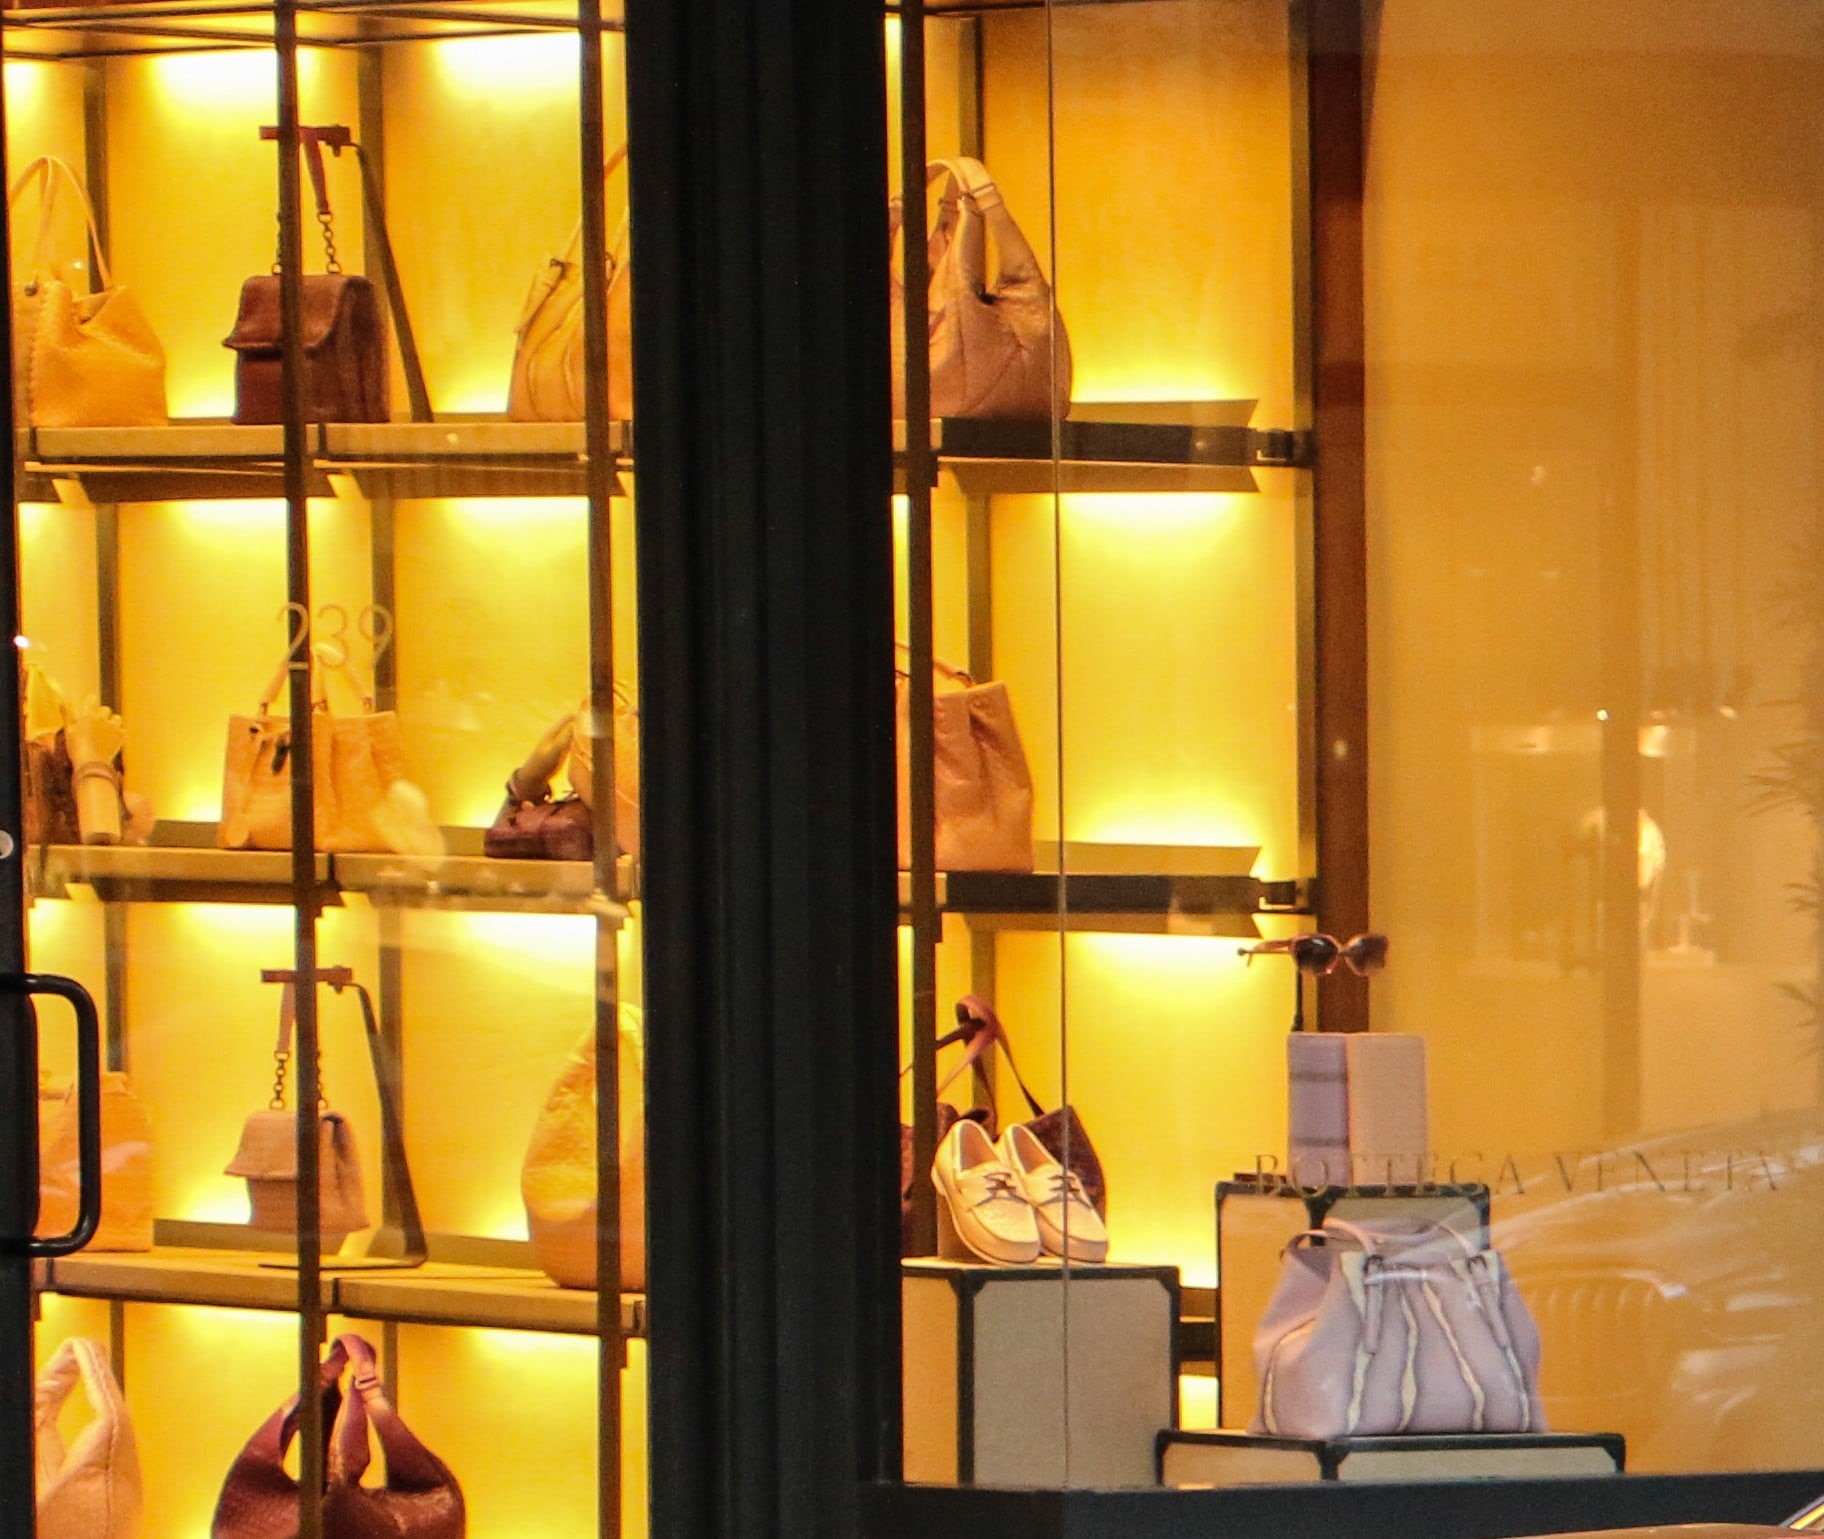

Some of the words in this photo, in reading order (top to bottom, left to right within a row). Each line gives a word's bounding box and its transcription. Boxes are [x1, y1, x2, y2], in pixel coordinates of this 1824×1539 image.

[276, 601, 394, 670] 239
[1255, 1152, 1525, 1198] BOTTEGA
[1552, 1148, 1777, 1192] VENETA
